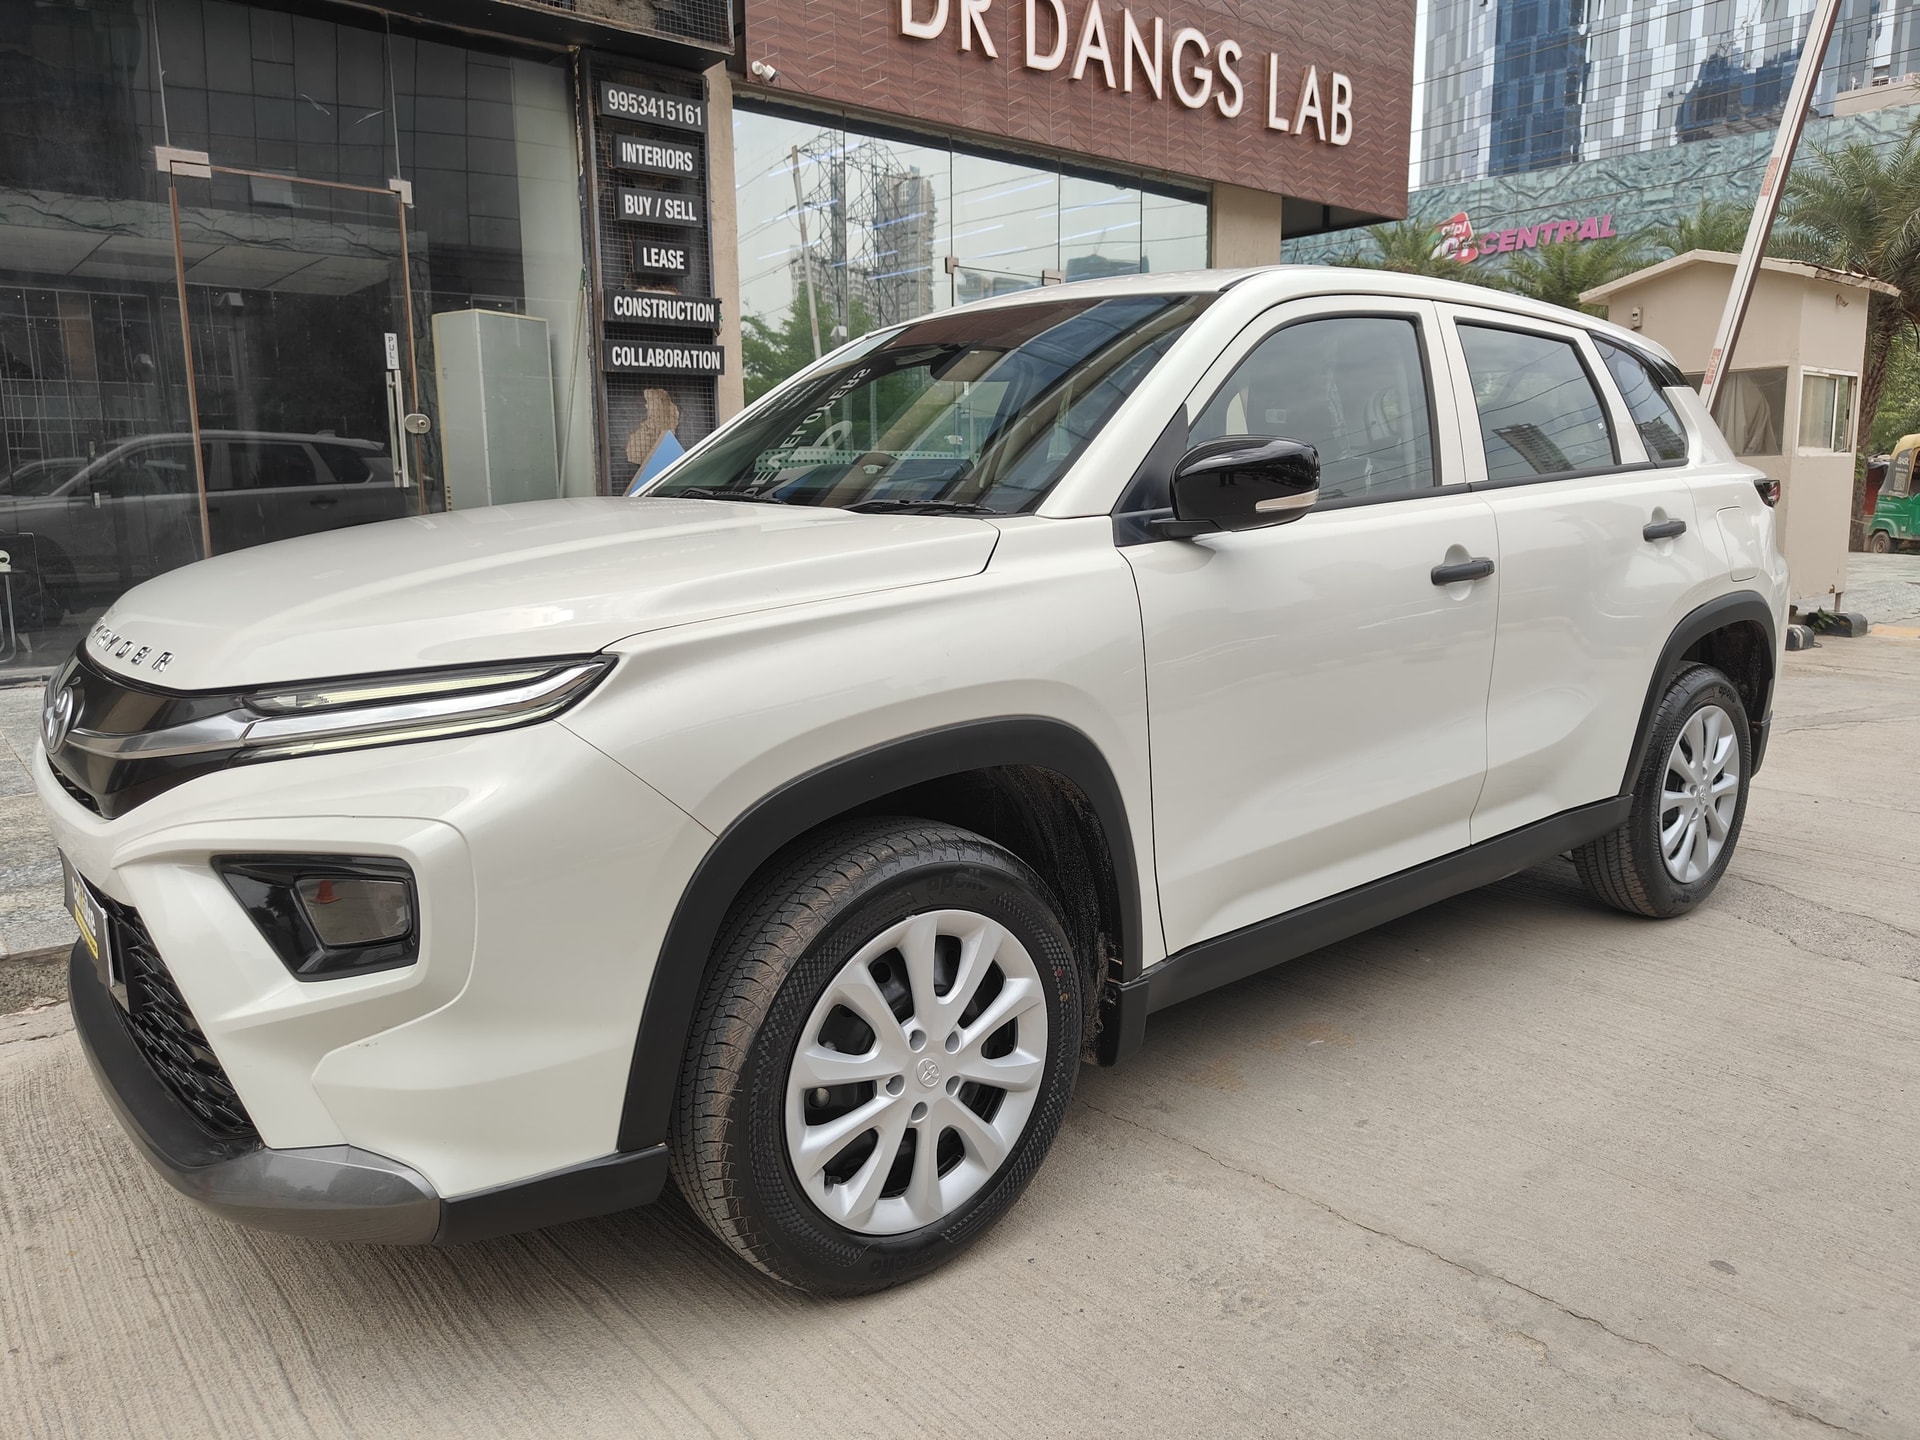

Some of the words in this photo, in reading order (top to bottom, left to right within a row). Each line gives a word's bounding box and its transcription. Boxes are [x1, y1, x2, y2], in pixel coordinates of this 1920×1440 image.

[1025, 0, 1245, 118] DANGS
[1264, 52, 1354, 146] LAB
[608, 88, 702, 126] 9953415161
[622, 142, 693, 171] INTERIORS
[624, 194, 651, 217] BUY
[665, 199, 697, 221] SELL
[1479, 214, 1616, 255] CENTRAL
[643, 246, 685, 270] LEASE
[613, 295, 715, 322] CONSTRUCTION
[387, 336, 396, 367] PULL
[612, 346, 721, 370] COLLABORATION
